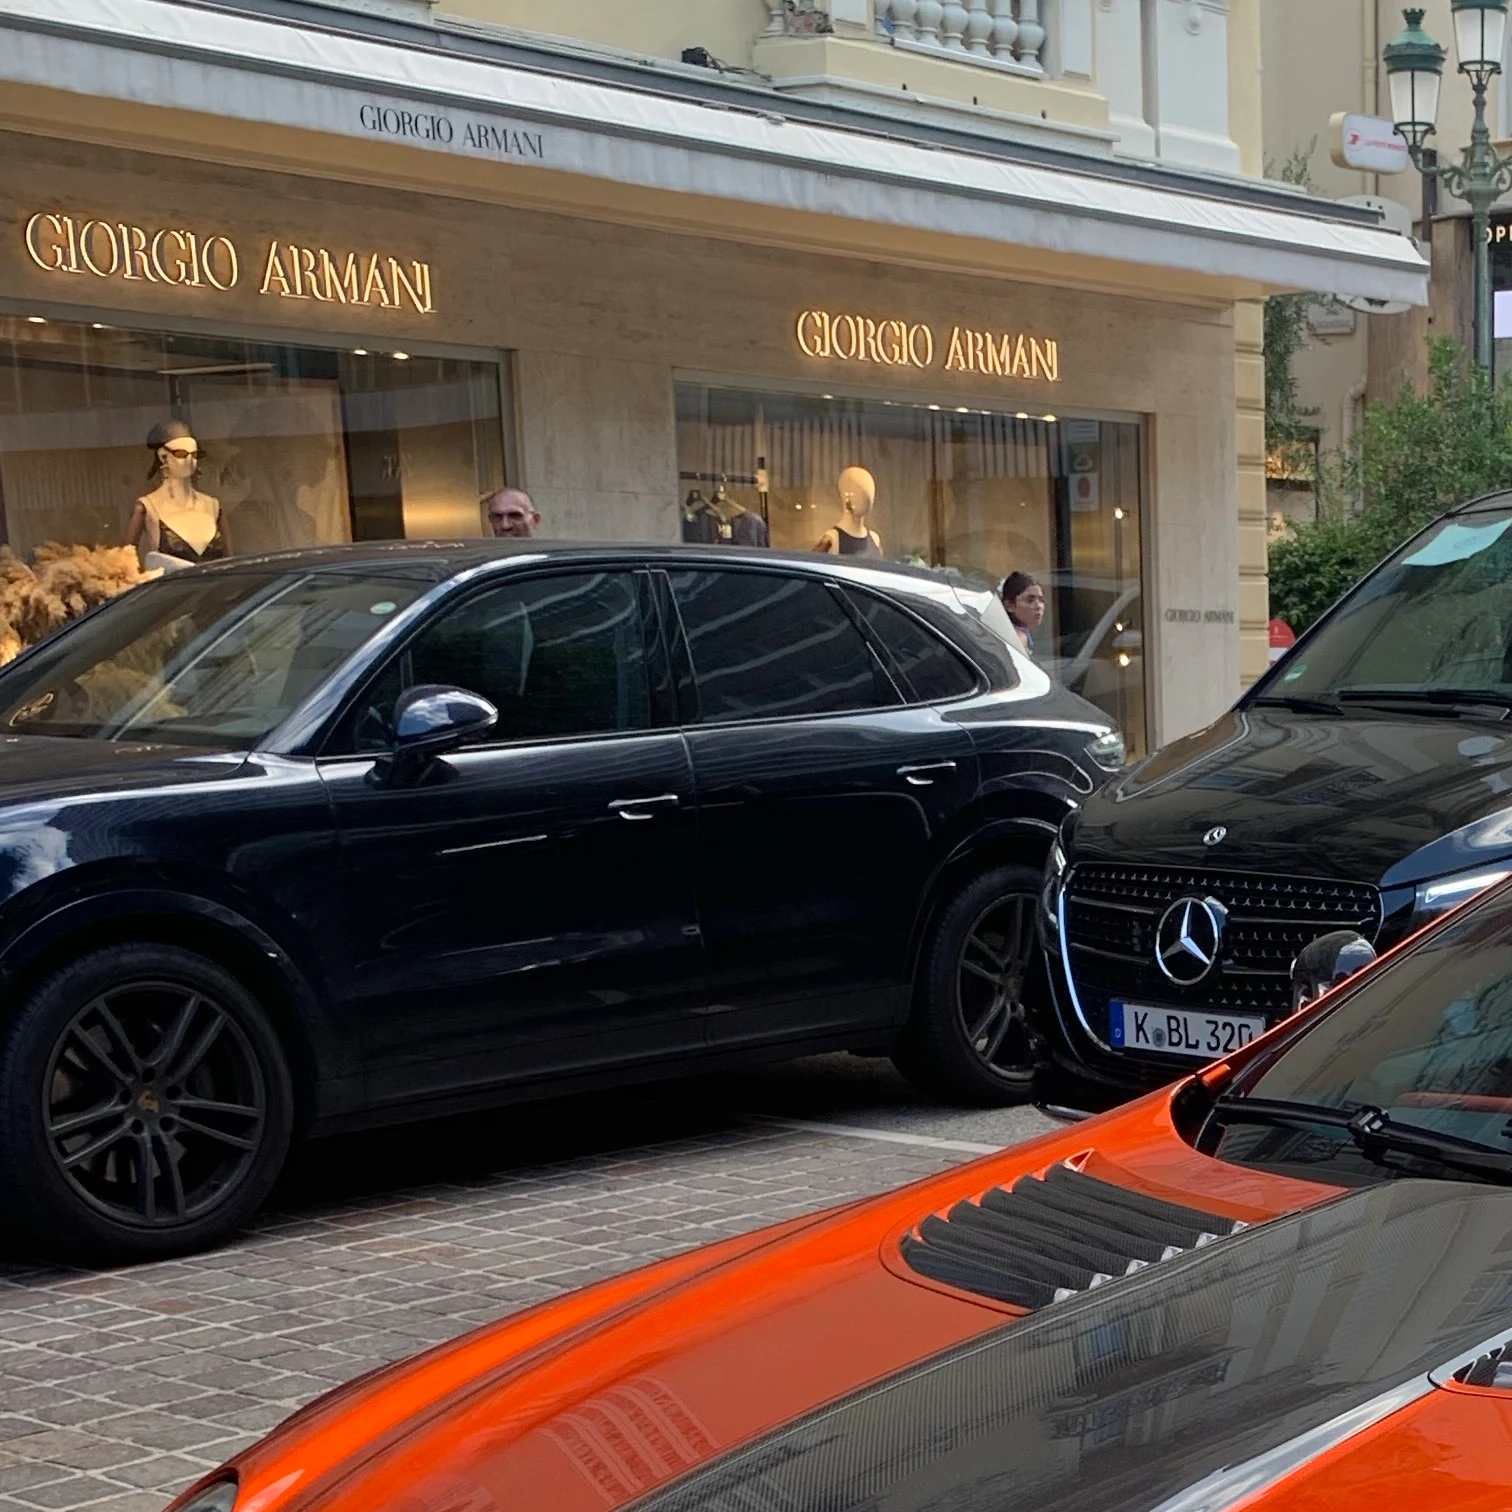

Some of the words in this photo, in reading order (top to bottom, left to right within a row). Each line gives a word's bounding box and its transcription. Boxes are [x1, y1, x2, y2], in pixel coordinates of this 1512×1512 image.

[360, 104, 454, 143] GIORGIO
[463, 123, 544, 158] ARMANI
[26, 212, 240, 291] GIORGIO
[259, 240, 438, 314] ARMANI
[797, 310, 934, 368] GIORGIO
[944, 326, 1062, 382] ARMANI
[1165, 609, 1200, 623] GIORGIO
[1204, 610, 1234, 624] ARMANI
[1134, 1012, 1150, 1043] K
[1166, 1015, 1200, 1050] BL
